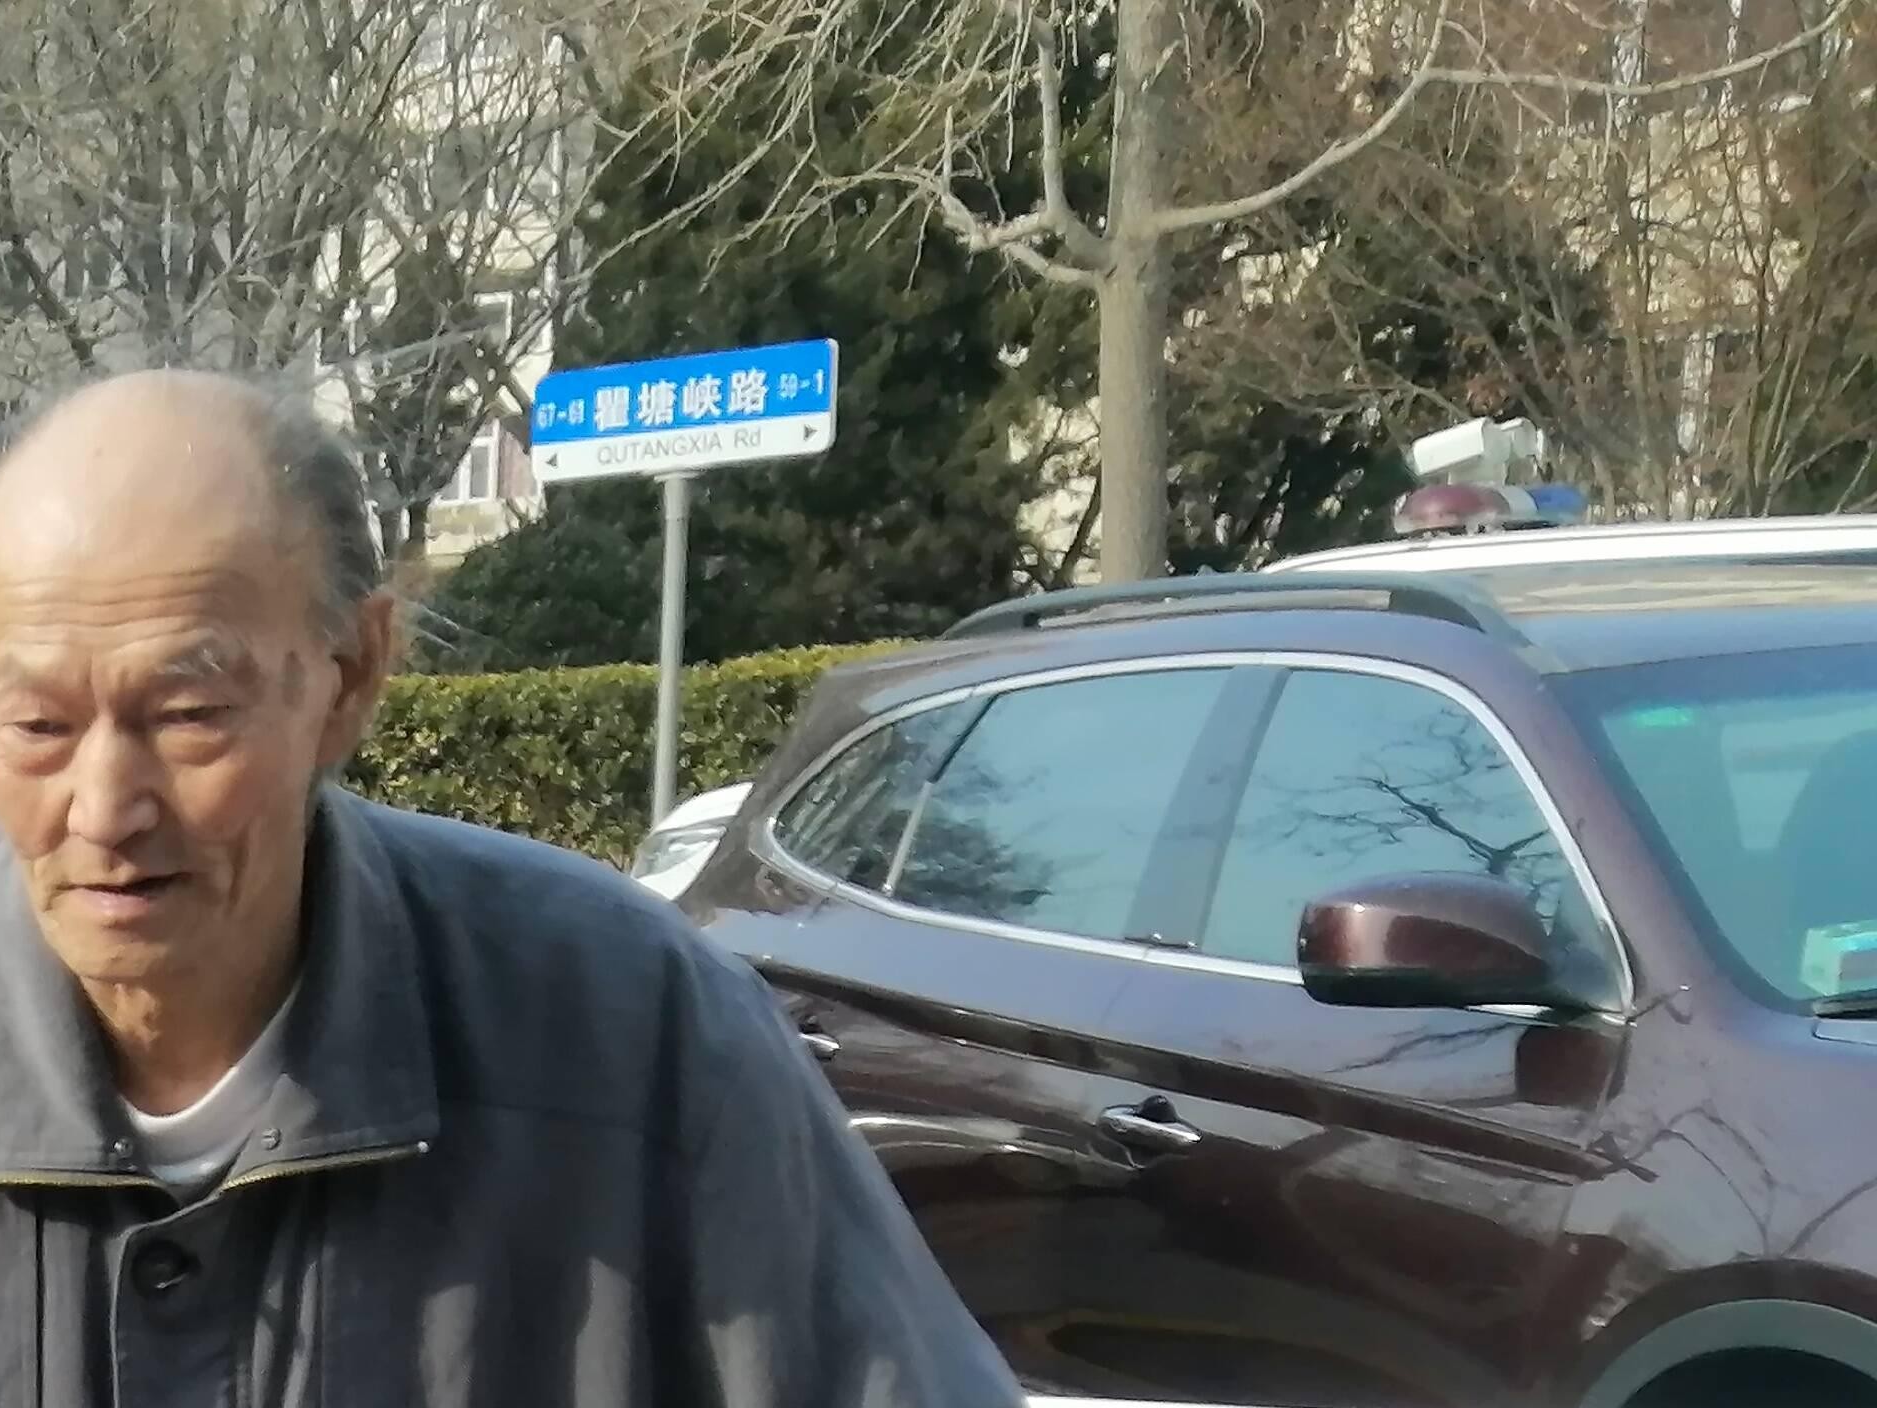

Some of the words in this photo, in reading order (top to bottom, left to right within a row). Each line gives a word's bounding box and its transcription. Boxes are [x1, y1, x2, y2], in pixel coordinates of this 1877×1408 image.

[594, 367, 768, 431] 瞿塘峡路
[596, 432, 722, 466] QUTANGXIA
[734, 428, 762, 449] Rd
